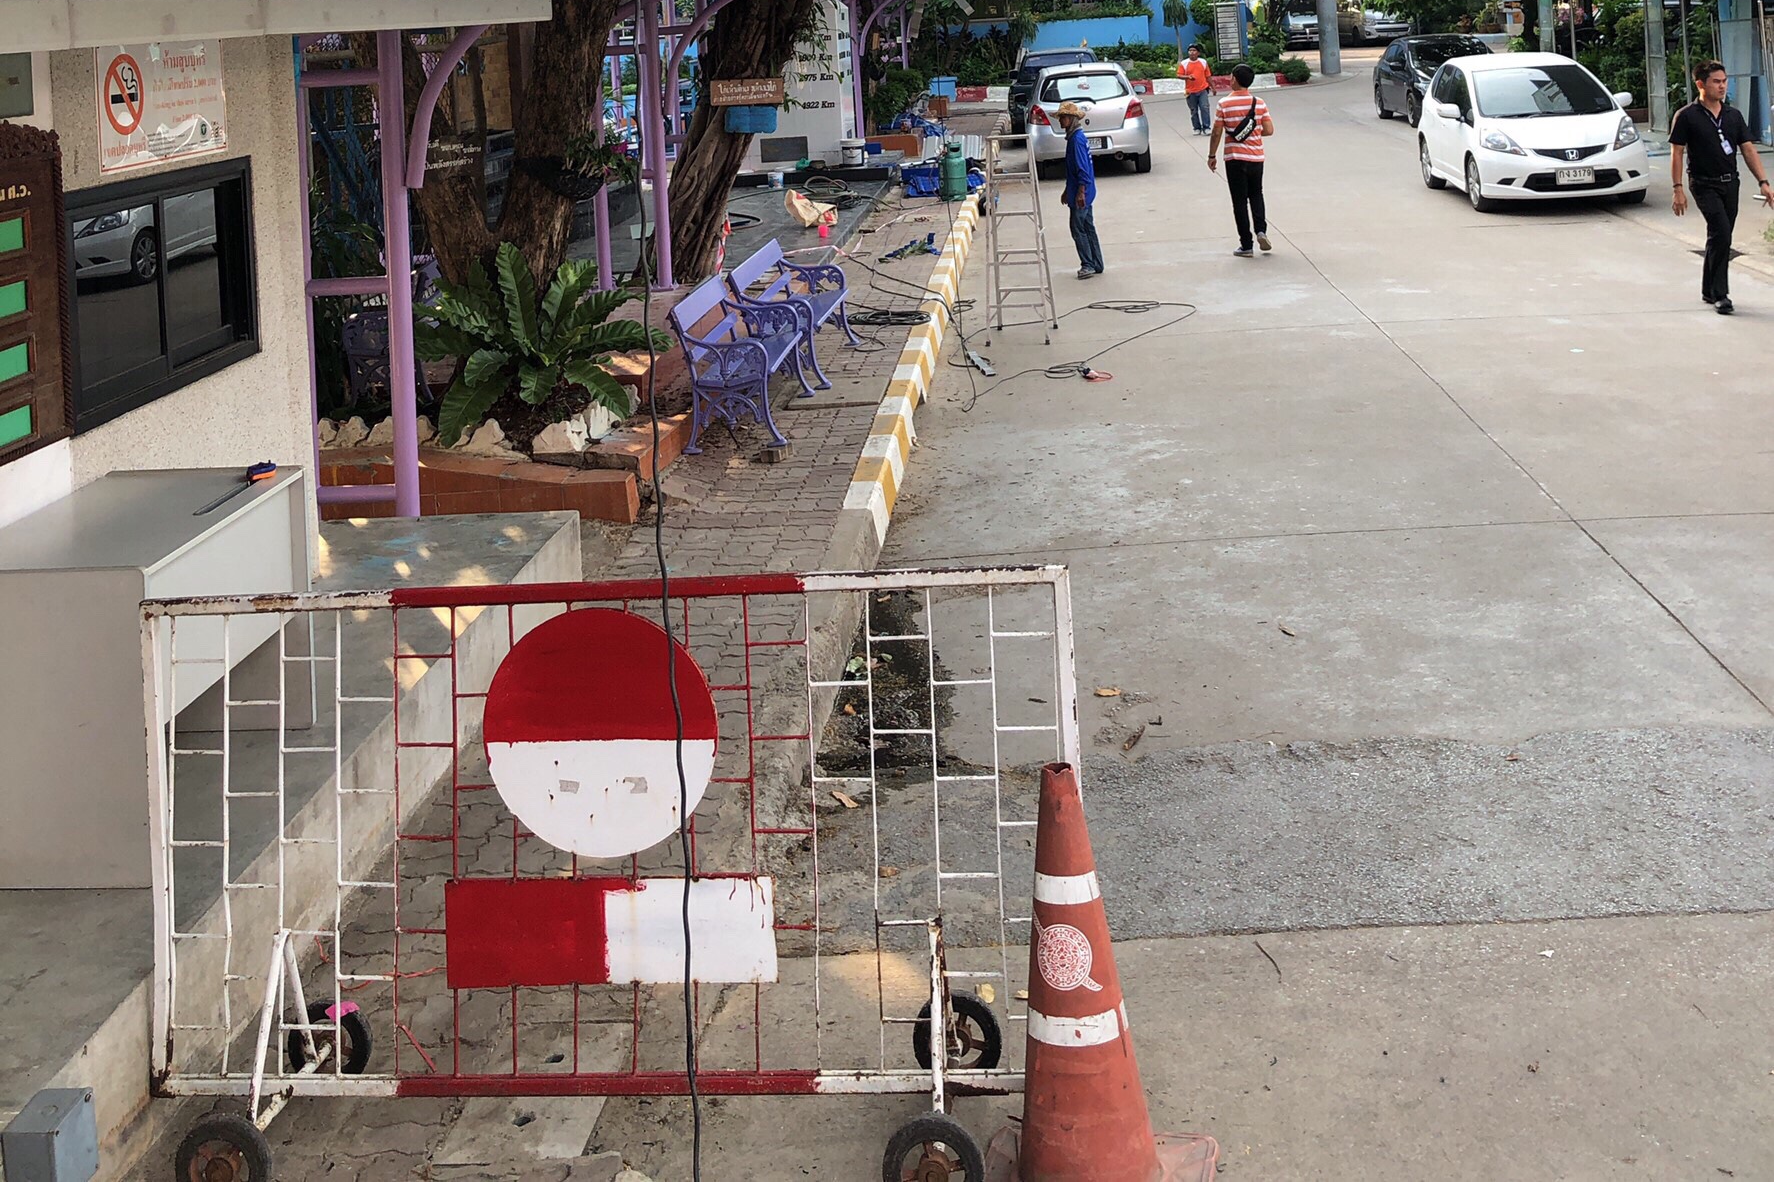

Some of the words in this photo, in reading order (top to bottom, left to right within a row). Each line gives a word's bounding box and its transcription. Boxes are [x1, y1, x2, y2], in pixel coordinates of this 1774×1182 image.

[820, 73, 834, 81] Km
[821, 100, 835, 108] Km
[1573, 169, 1591, 177] 3179
